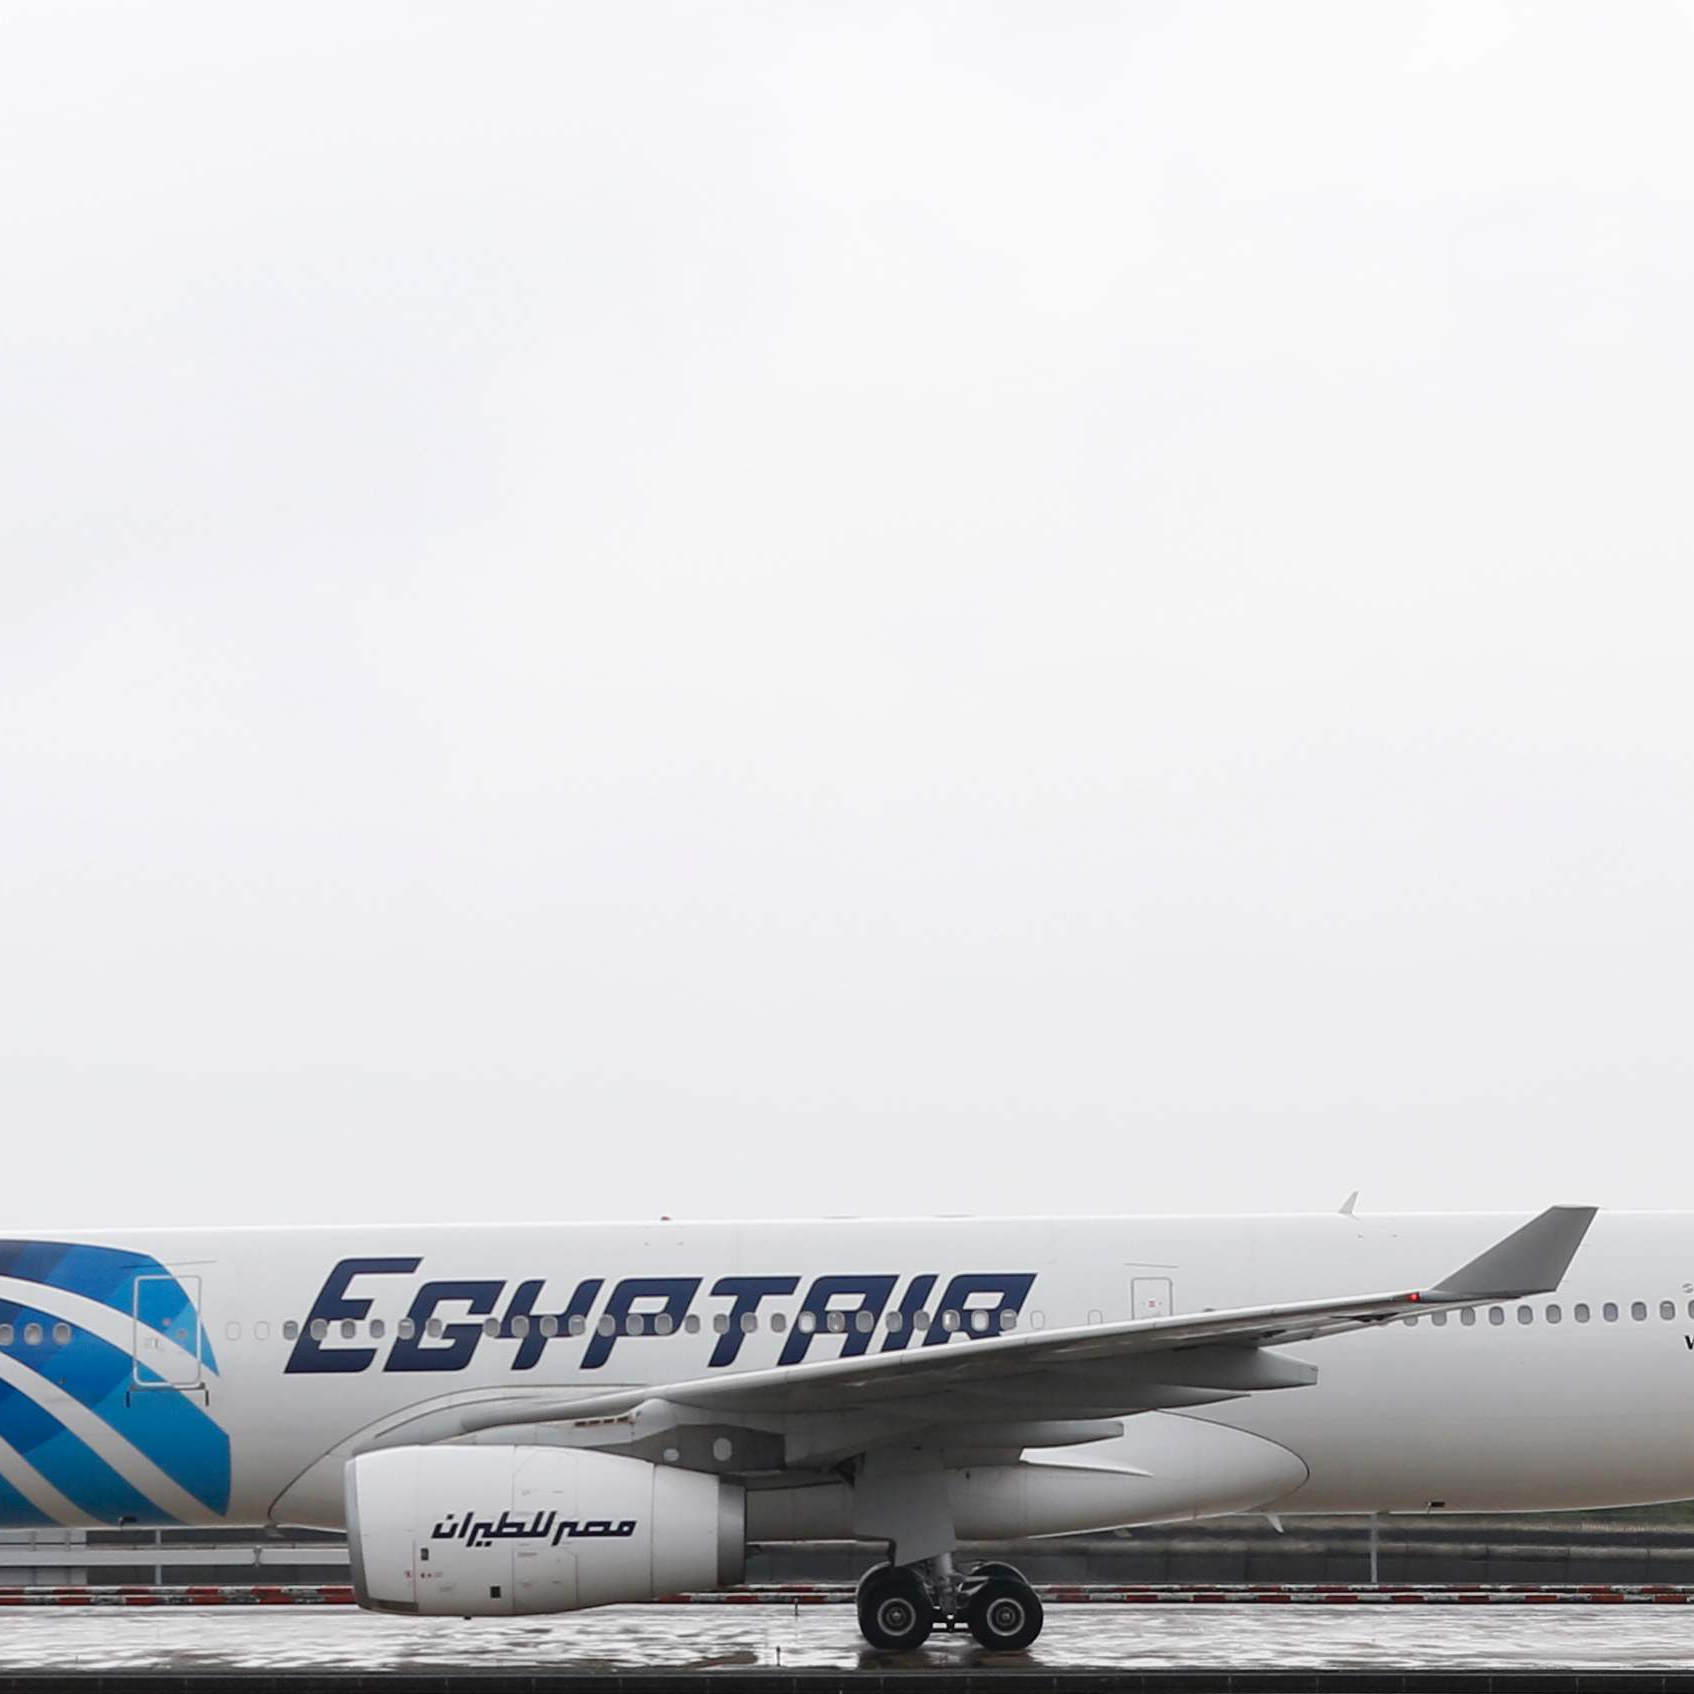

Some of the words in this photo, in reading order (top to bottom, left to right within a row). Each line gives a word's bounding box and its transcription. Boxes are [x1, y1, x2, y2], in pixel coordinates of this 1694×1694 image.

[284, 1257, 1037, 1373] EGYPTAIR
[431, 1511, 557, 1548] للطيران
[551, 1520, 637, 1547] مصر
